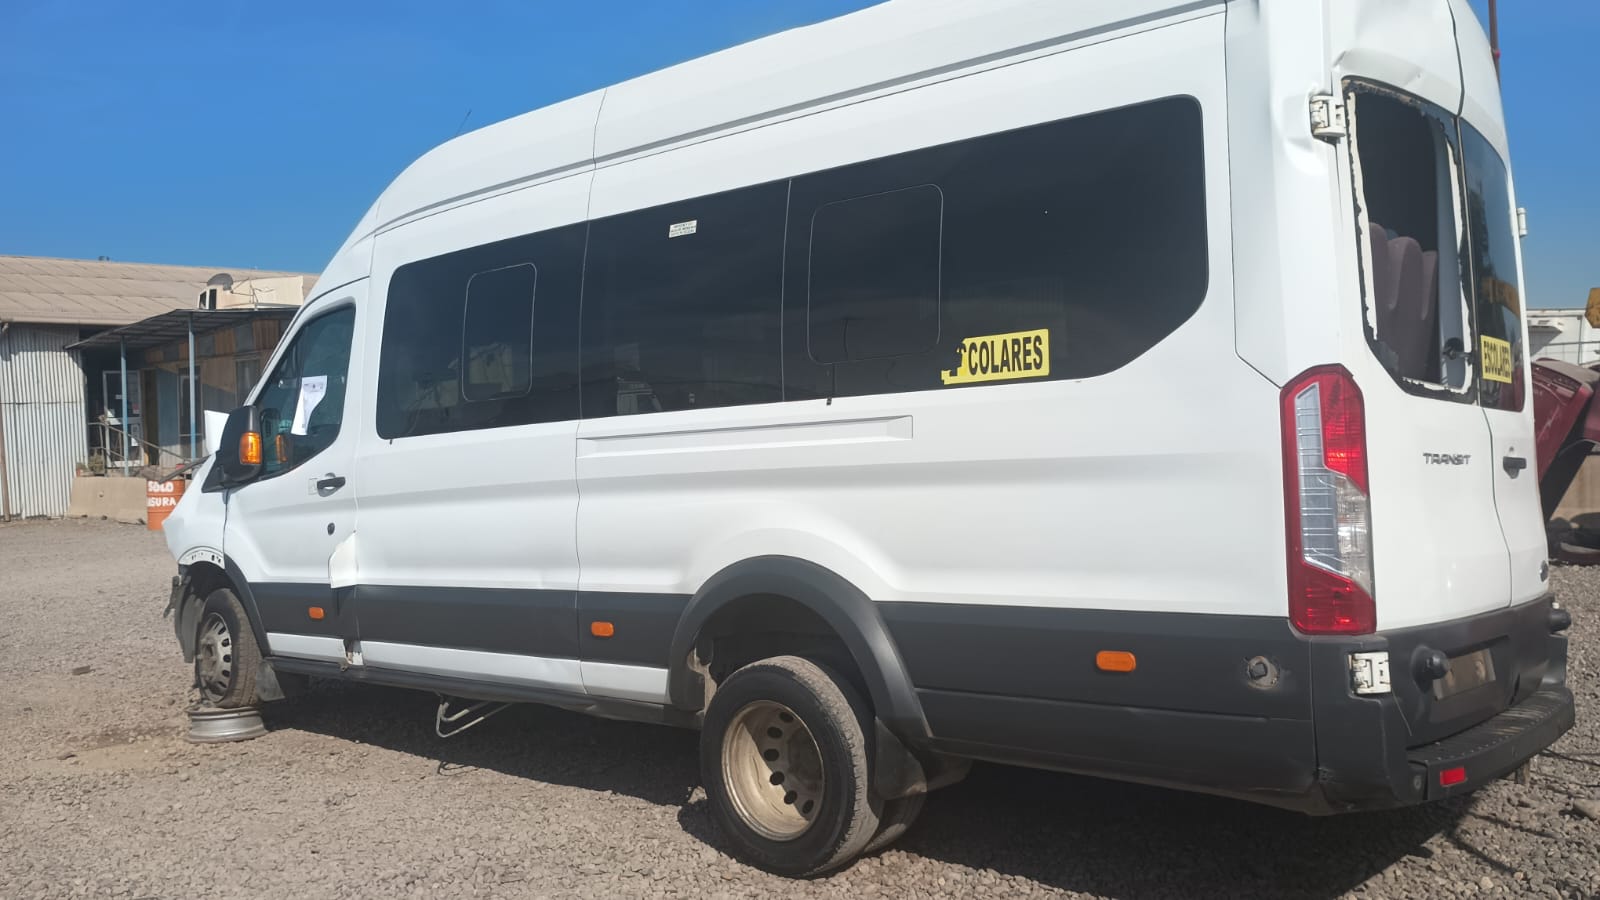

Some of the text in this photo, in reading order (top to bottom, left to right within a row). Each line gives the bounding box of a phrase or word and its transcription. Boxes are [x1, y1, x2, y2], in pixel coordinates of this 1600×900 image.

[1483, 340, 1511, 379] ESCOLARES
[1423, 452, 1471, 465] TRANSIT
[147, 480, 173, 493] SOLO
